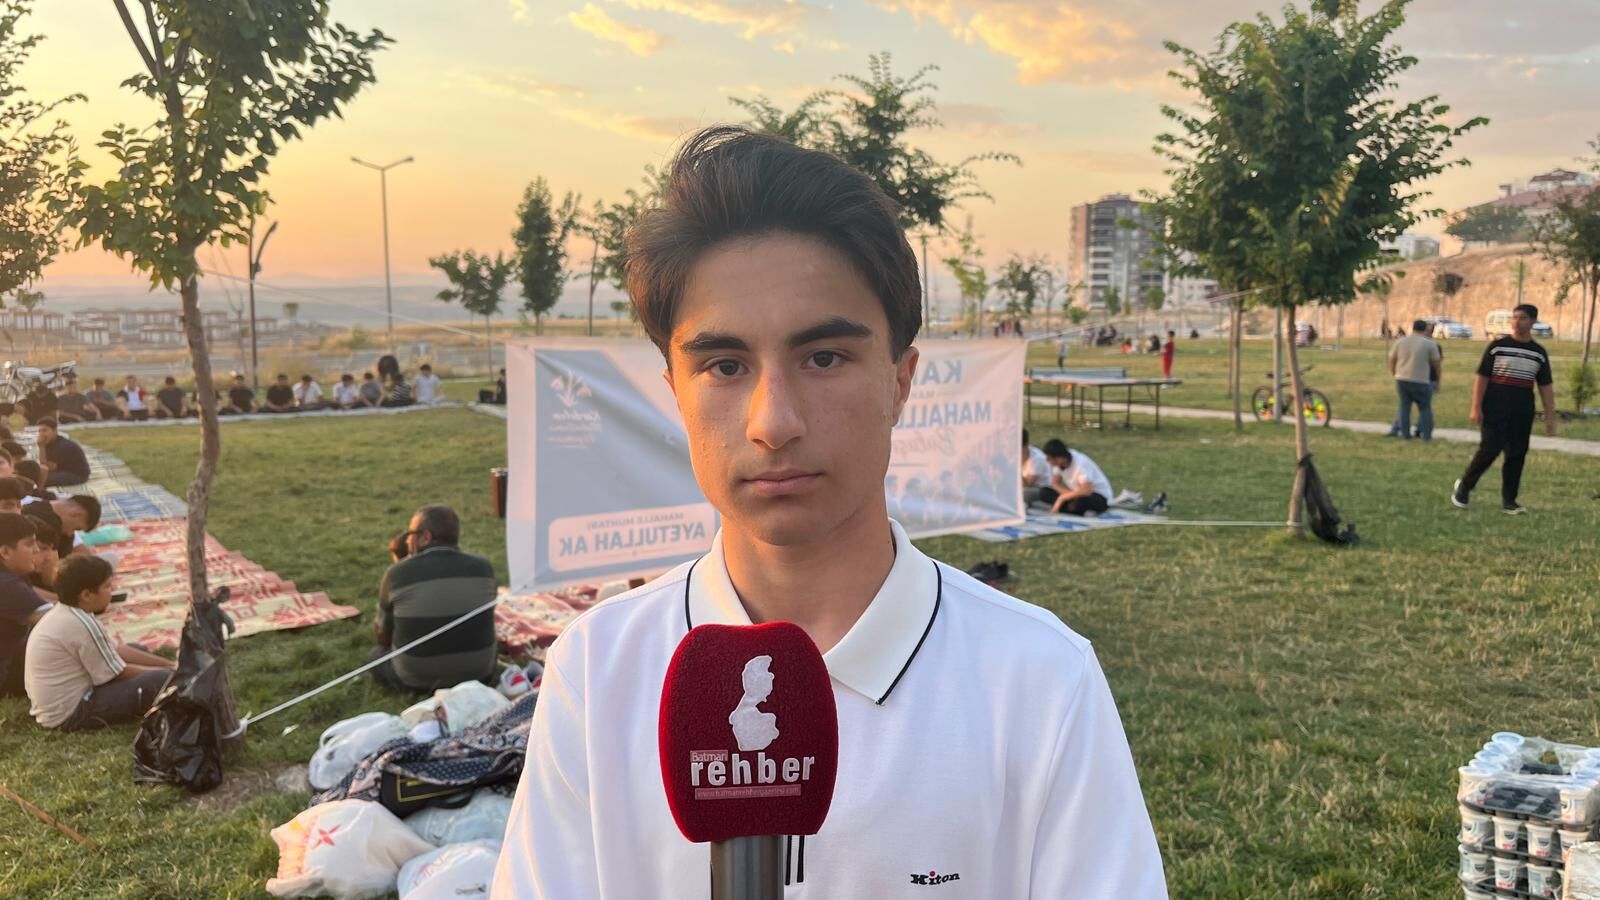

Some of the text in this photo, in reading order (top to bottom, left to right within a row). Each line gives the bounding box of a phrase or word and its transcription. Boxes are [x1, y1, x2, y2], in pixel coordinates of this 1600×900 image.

[691, 751, 728, 762] Batman
[691, 752, 815, 786] rehber
[910, 870, 960, 885] Kiton
